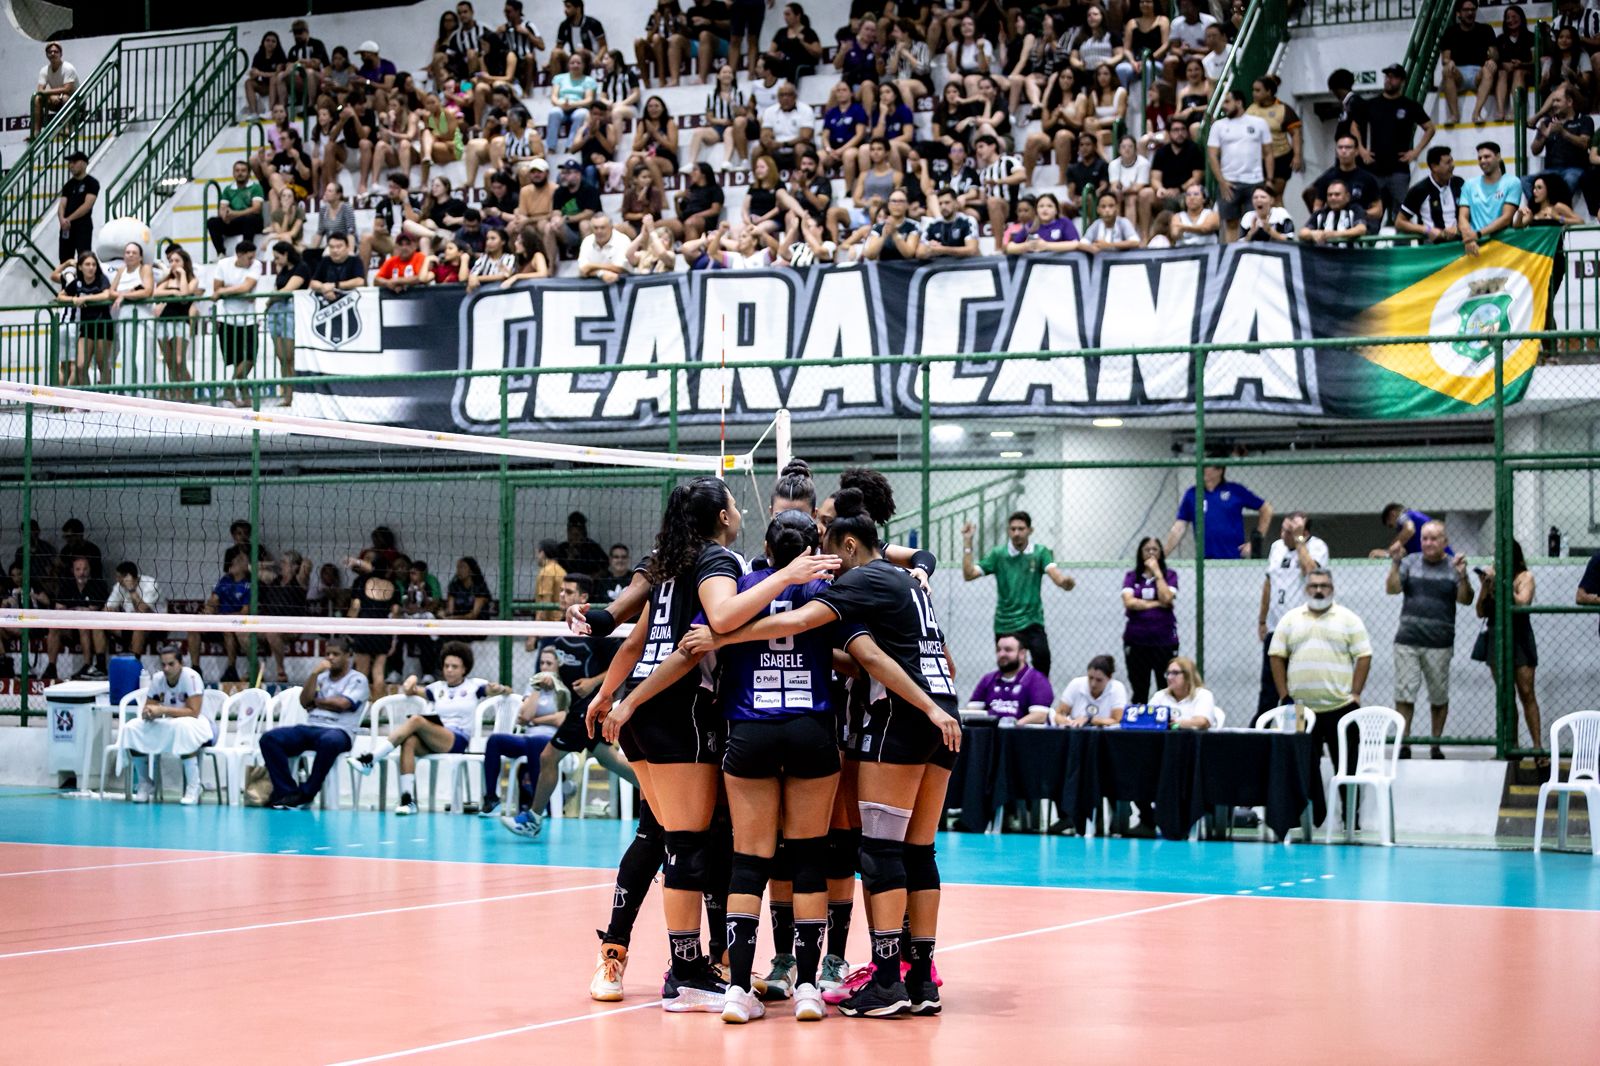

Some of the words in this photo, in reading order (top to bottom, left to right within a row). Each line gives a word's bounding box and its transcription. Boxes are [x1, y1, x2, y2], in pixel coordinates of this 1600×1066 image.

[653, 577, 675, 625] 9
[910, 588, 940, 638] 14
[760, 652, 804, 668] ISABELE
[763, 675, 779, 683] Pulse
